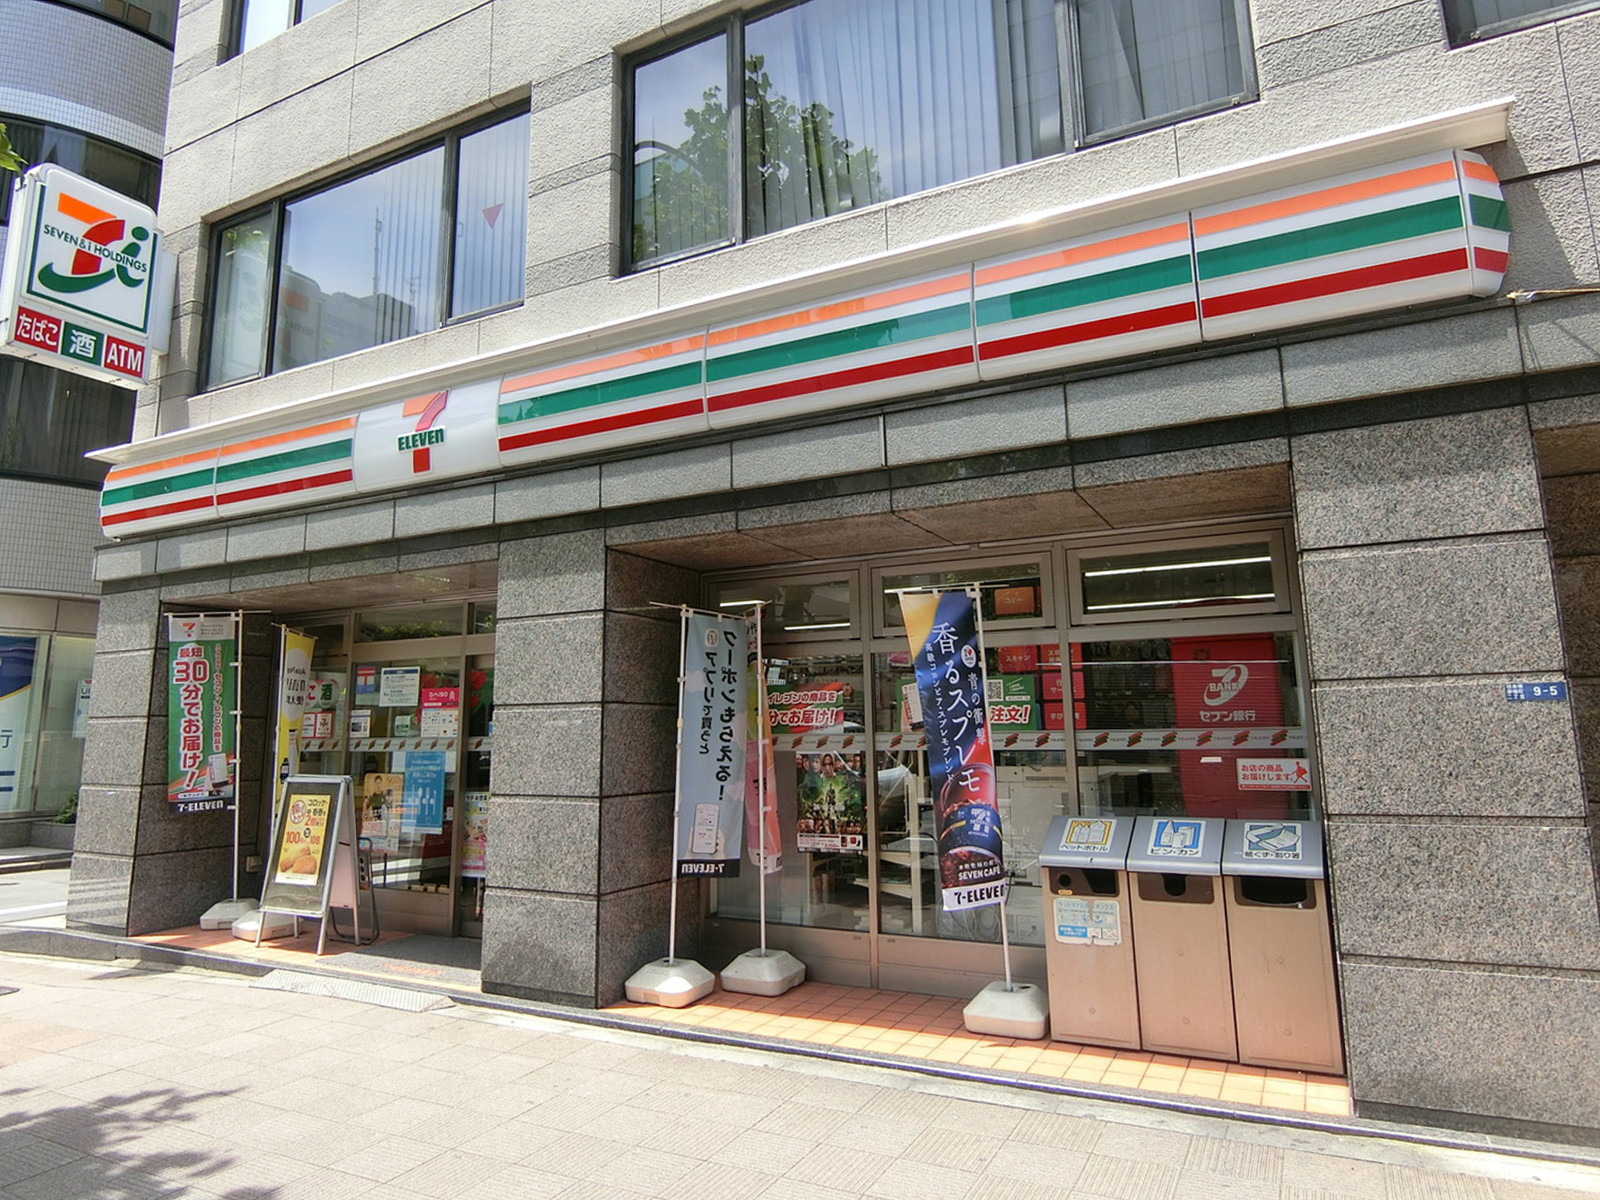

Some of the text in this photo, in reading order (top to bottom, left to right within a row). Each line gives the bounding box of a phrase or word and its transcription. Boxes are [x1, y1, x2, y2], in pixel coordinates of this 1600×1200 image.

[93, 244, 148, 273] HOLDINGS
[17, 313, 59, 347] たばこ
[70, 329, 97, 358] 酒
[107, 342, 143, 373] ATM
[320, 683, 333, 701] 酒
[1209, 682, 1240, 692] BANK
[1533, 685, 1558, 696] 9-5
[931, 621, 980, 794] 香るスプレモ
[990, 705, 1030, 723] 注文!
[1199, 710, 1257, 722] セブン銀行
[1241, 764, 1284, 772] お店の商品
[1241, 773, 1292, 782] お届けします
[1060, 844, 1109, 852] ペットボトル
[958, 869, 984, 881] SEVEN
